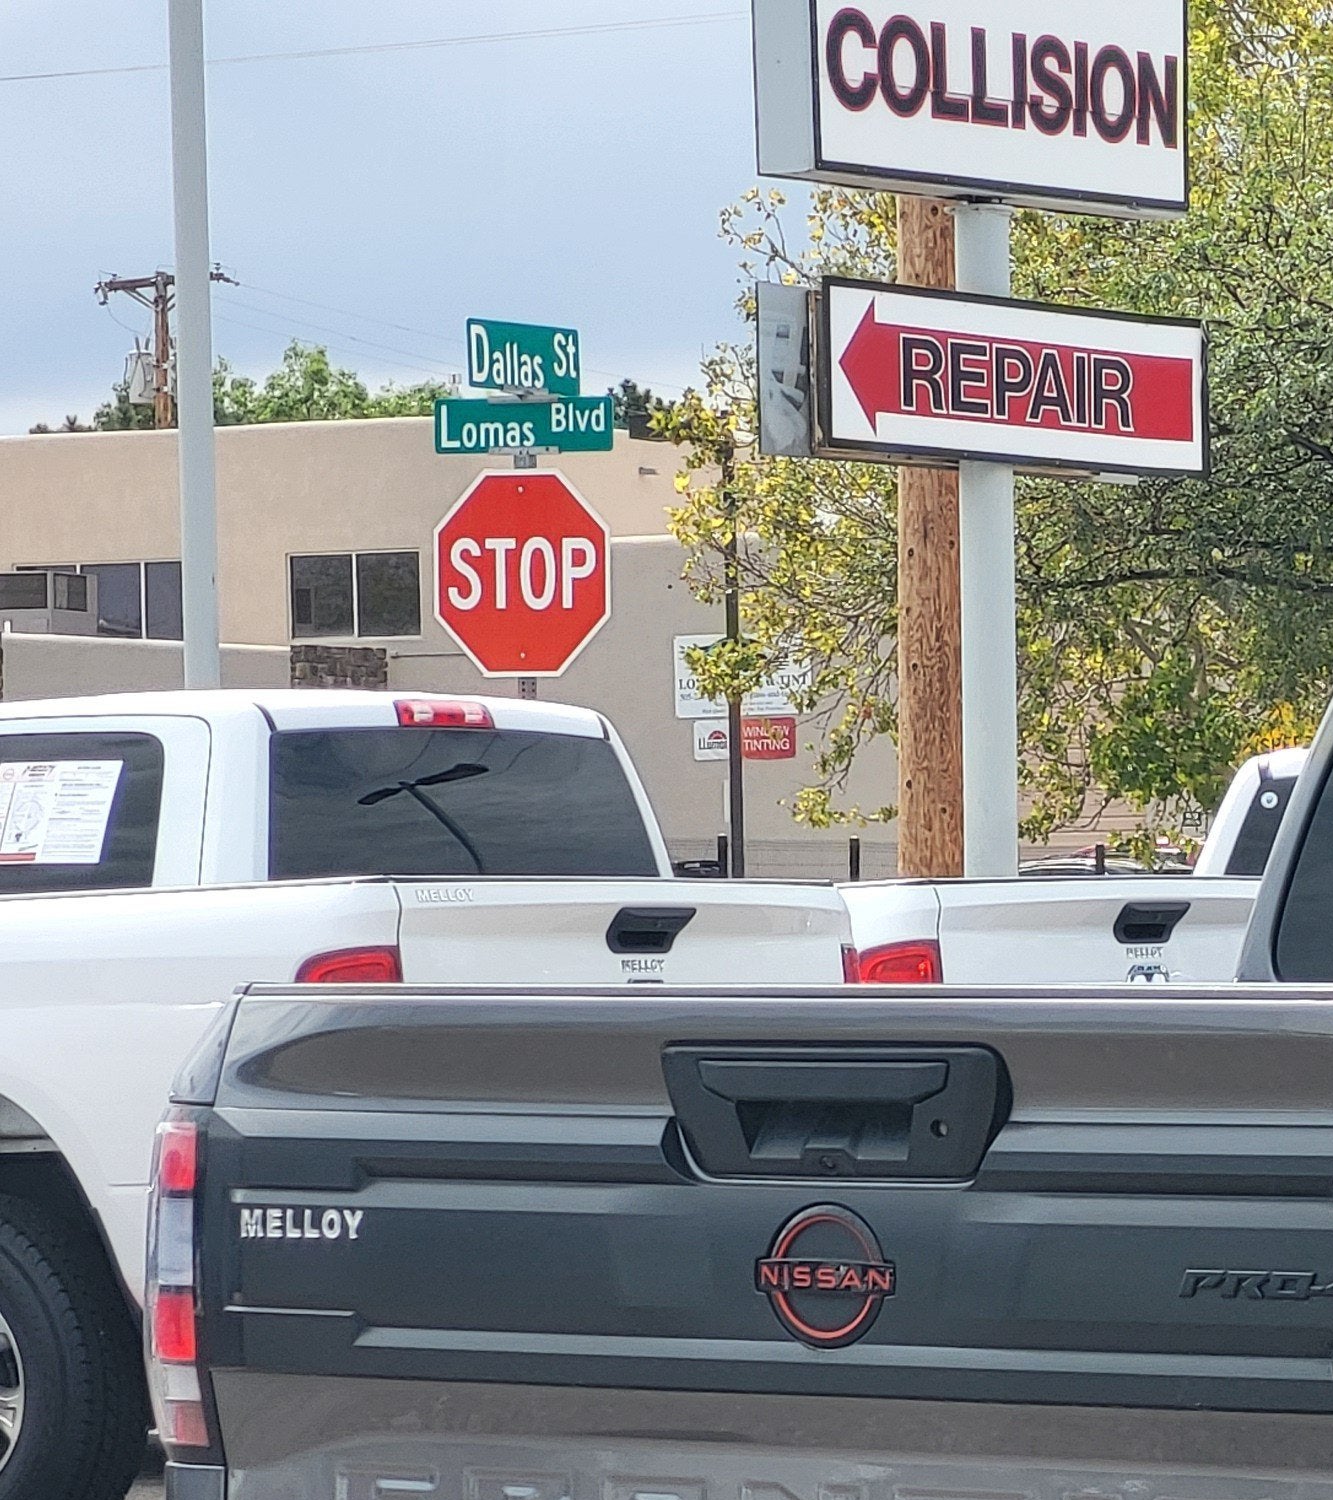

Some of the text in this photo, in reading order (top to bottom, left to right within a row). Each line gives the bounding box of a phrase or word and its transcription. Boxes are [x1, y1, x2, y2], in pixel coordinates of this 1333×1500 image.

[826, 7, 1178, 149] COLLISION
[469, 324, 577, 388] Dallas St
[899, 333, 1134, 432] REPAIR
[440, 402, 604, 448] Lomas Blvd
[448, 536, 596, 610] STOP
[743, 739, 790, 751] TINTING
[416, 889, 473, 902] MELLOY
[240, 1208, 363, 1239] MELLOY
[760, 1263, 892, 1291] NISSAN
